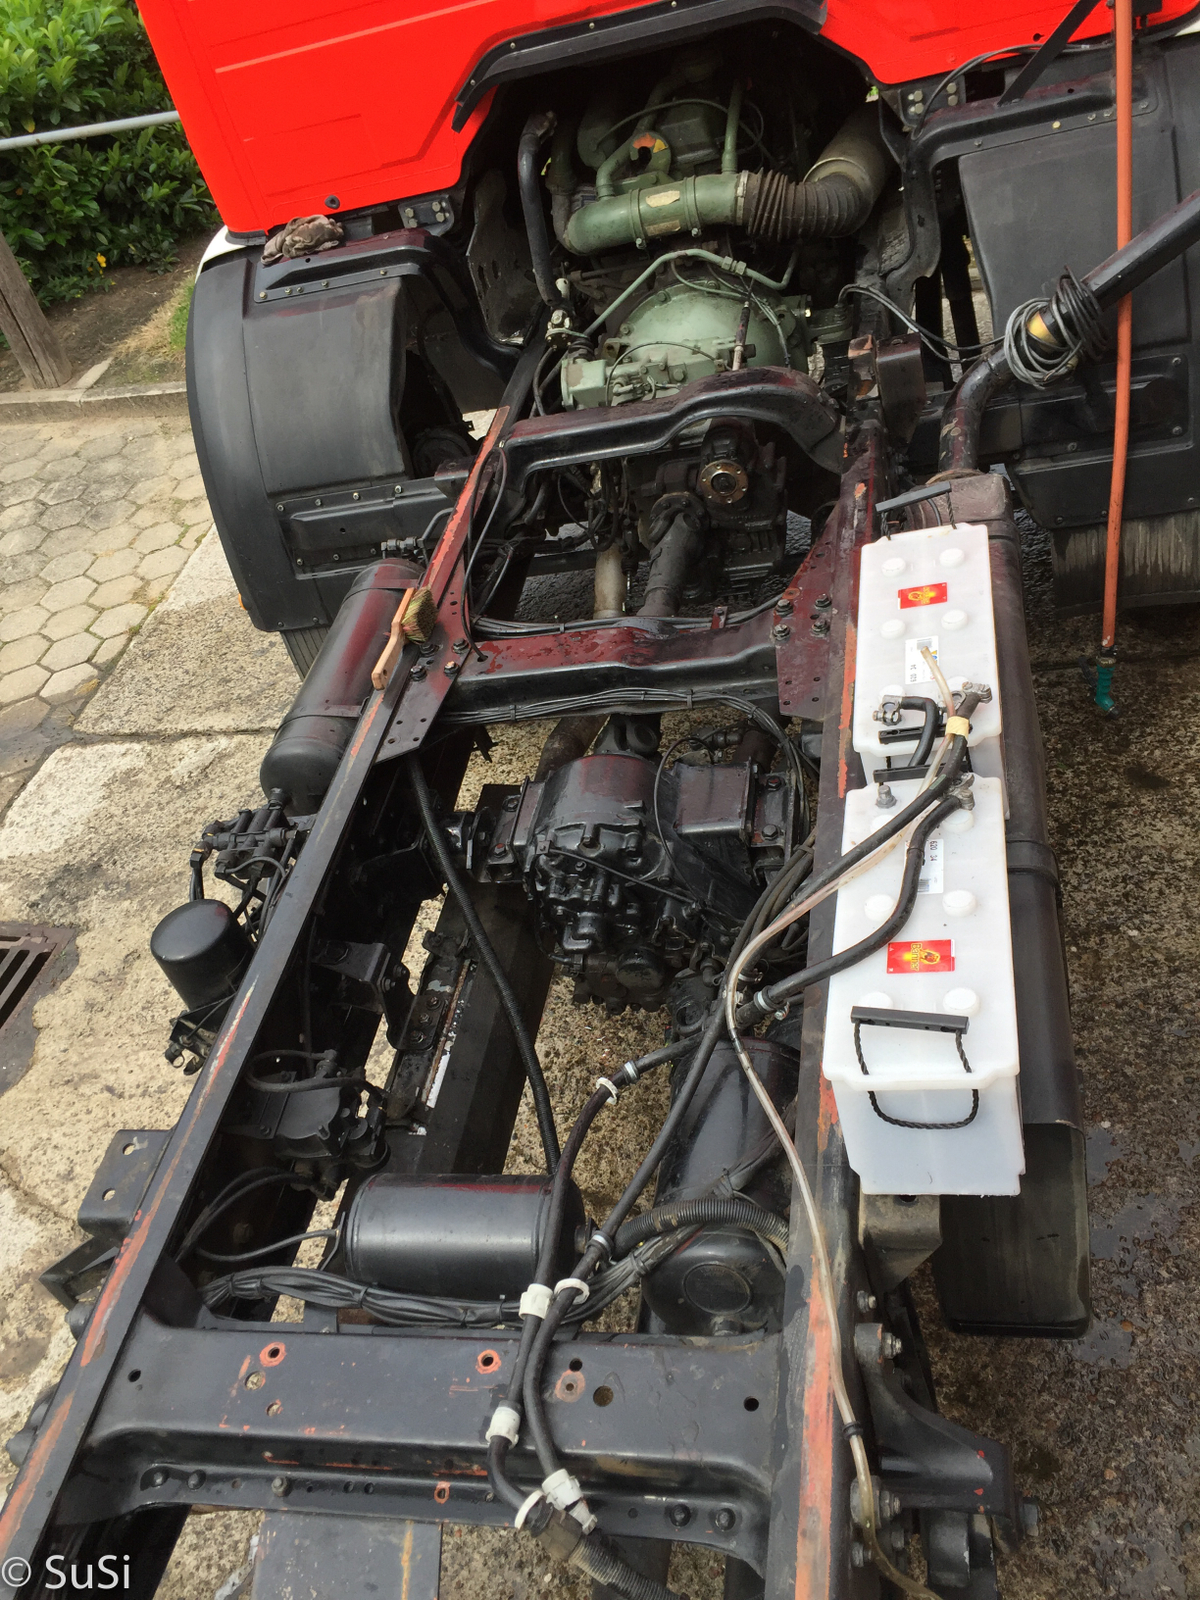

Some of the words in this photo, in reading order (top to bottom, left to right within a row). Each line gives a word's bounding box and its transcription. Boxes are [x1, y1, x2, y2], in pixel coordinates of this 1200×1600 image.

[929, 840, 938, 851] 620
[929, 854, 938, 862] 34
[911, 943, 922, 971] Banner
